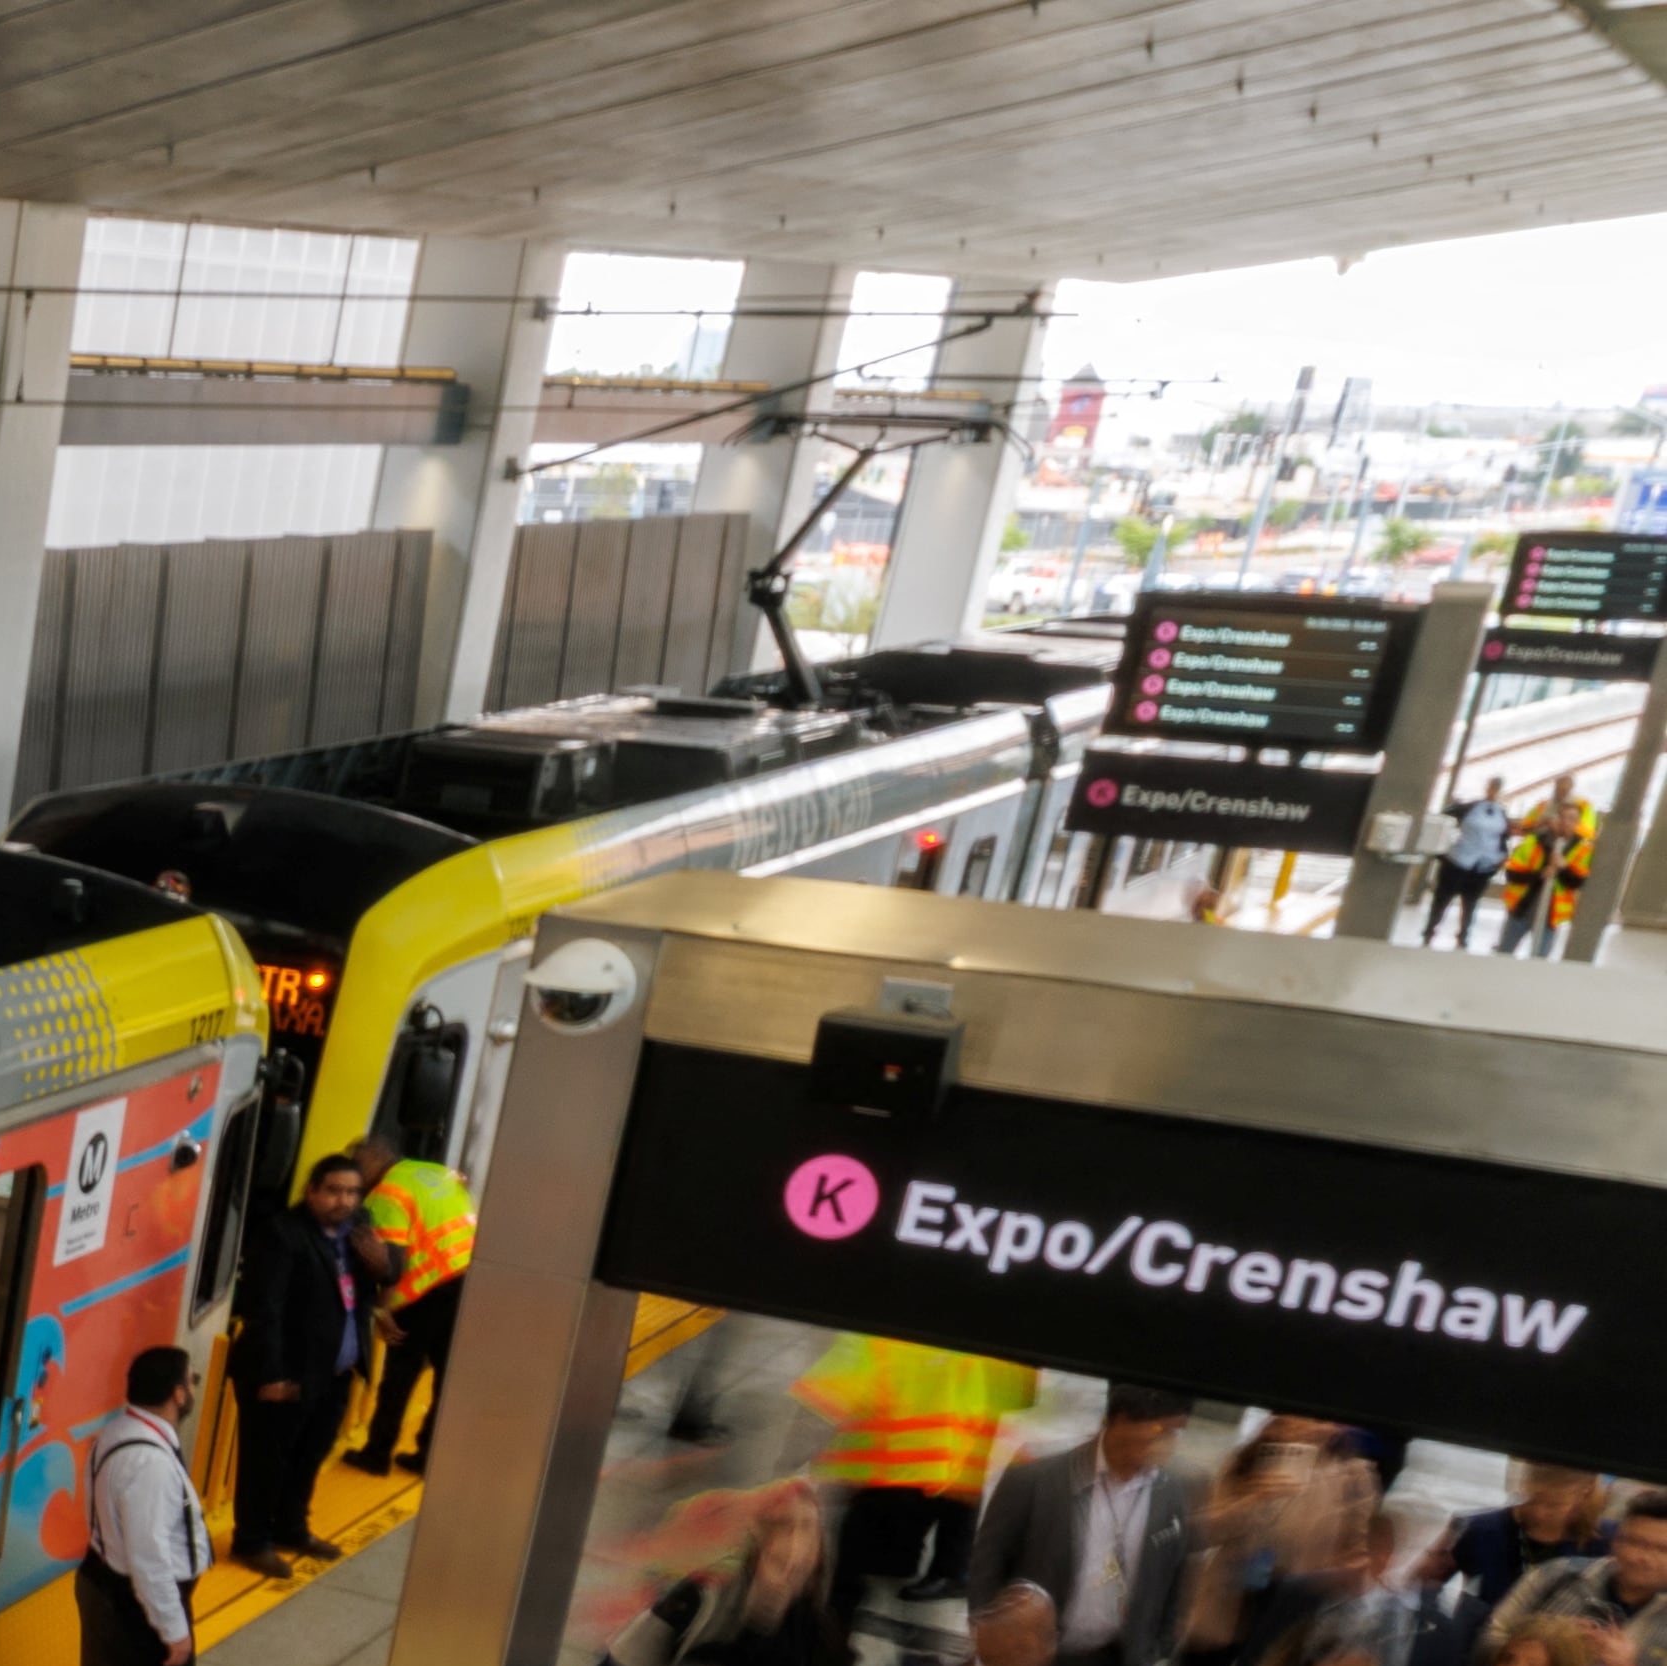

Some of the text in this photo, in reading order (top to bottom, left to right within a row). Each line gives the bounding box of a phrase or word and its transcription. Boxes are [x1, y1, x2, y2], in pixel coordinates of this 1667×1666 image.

[1120, 784, 1311, 821] Expo/Crenshaw
[257, 965, 301, 1006] TR
[70, 1202, 100, 1225] Metro
[895, 1179, 1587, 1355] Expo/Crenshaw
